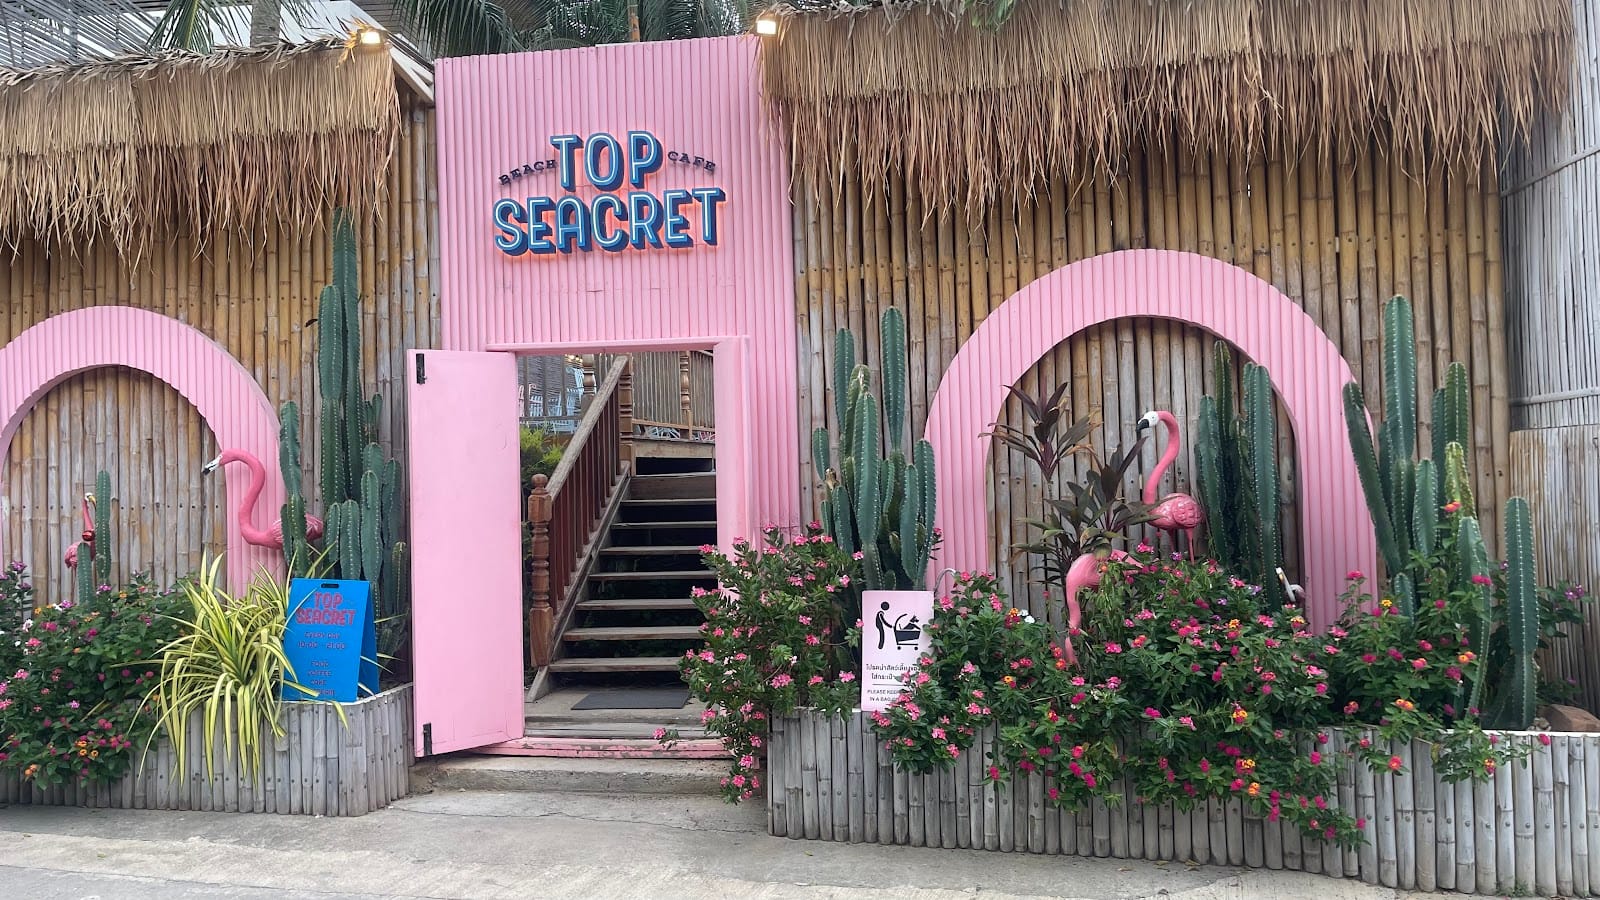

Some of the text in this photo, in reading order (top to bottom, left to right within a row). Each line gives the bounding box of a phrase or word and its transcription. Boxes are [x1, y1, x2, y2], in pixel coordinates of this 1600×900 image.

[498, 150, 716, 186] BEACH CAFE
[550, 130, 664, 192] TOP
[492, 187, 726, 257] SEACRET
[295, 607, 356, 626] SEACRET
[314, 591, 343, 609] TOP
